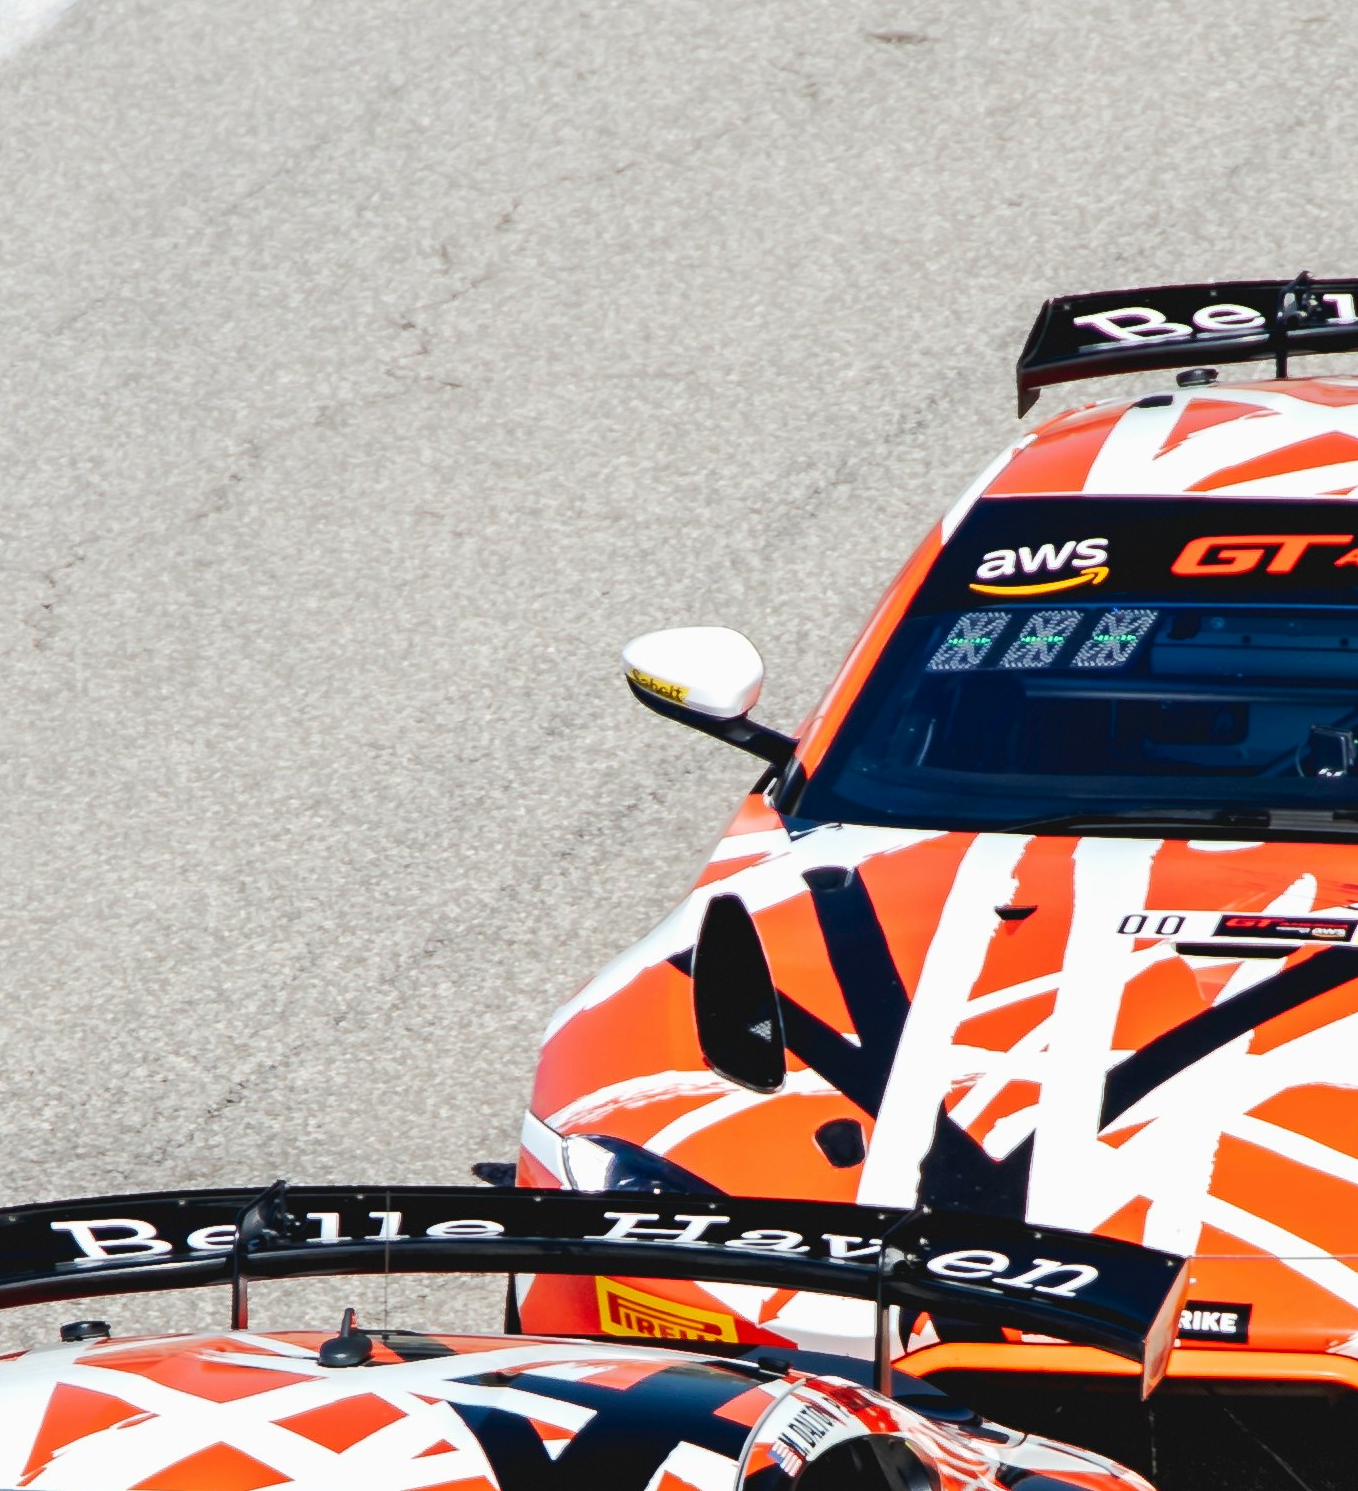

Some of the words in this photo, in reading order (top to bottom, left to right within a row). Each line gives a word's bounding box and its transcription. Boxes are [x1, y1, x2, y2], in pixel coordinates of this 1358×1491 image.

[976, 537, 1109, 580] aws
[1171, 535, 1354, 577] GT
[1116, 913, 1186, 936] 00
[51, 1211, 505, 1267] Belle
[584, 1212, 1099, 1298] Haven
